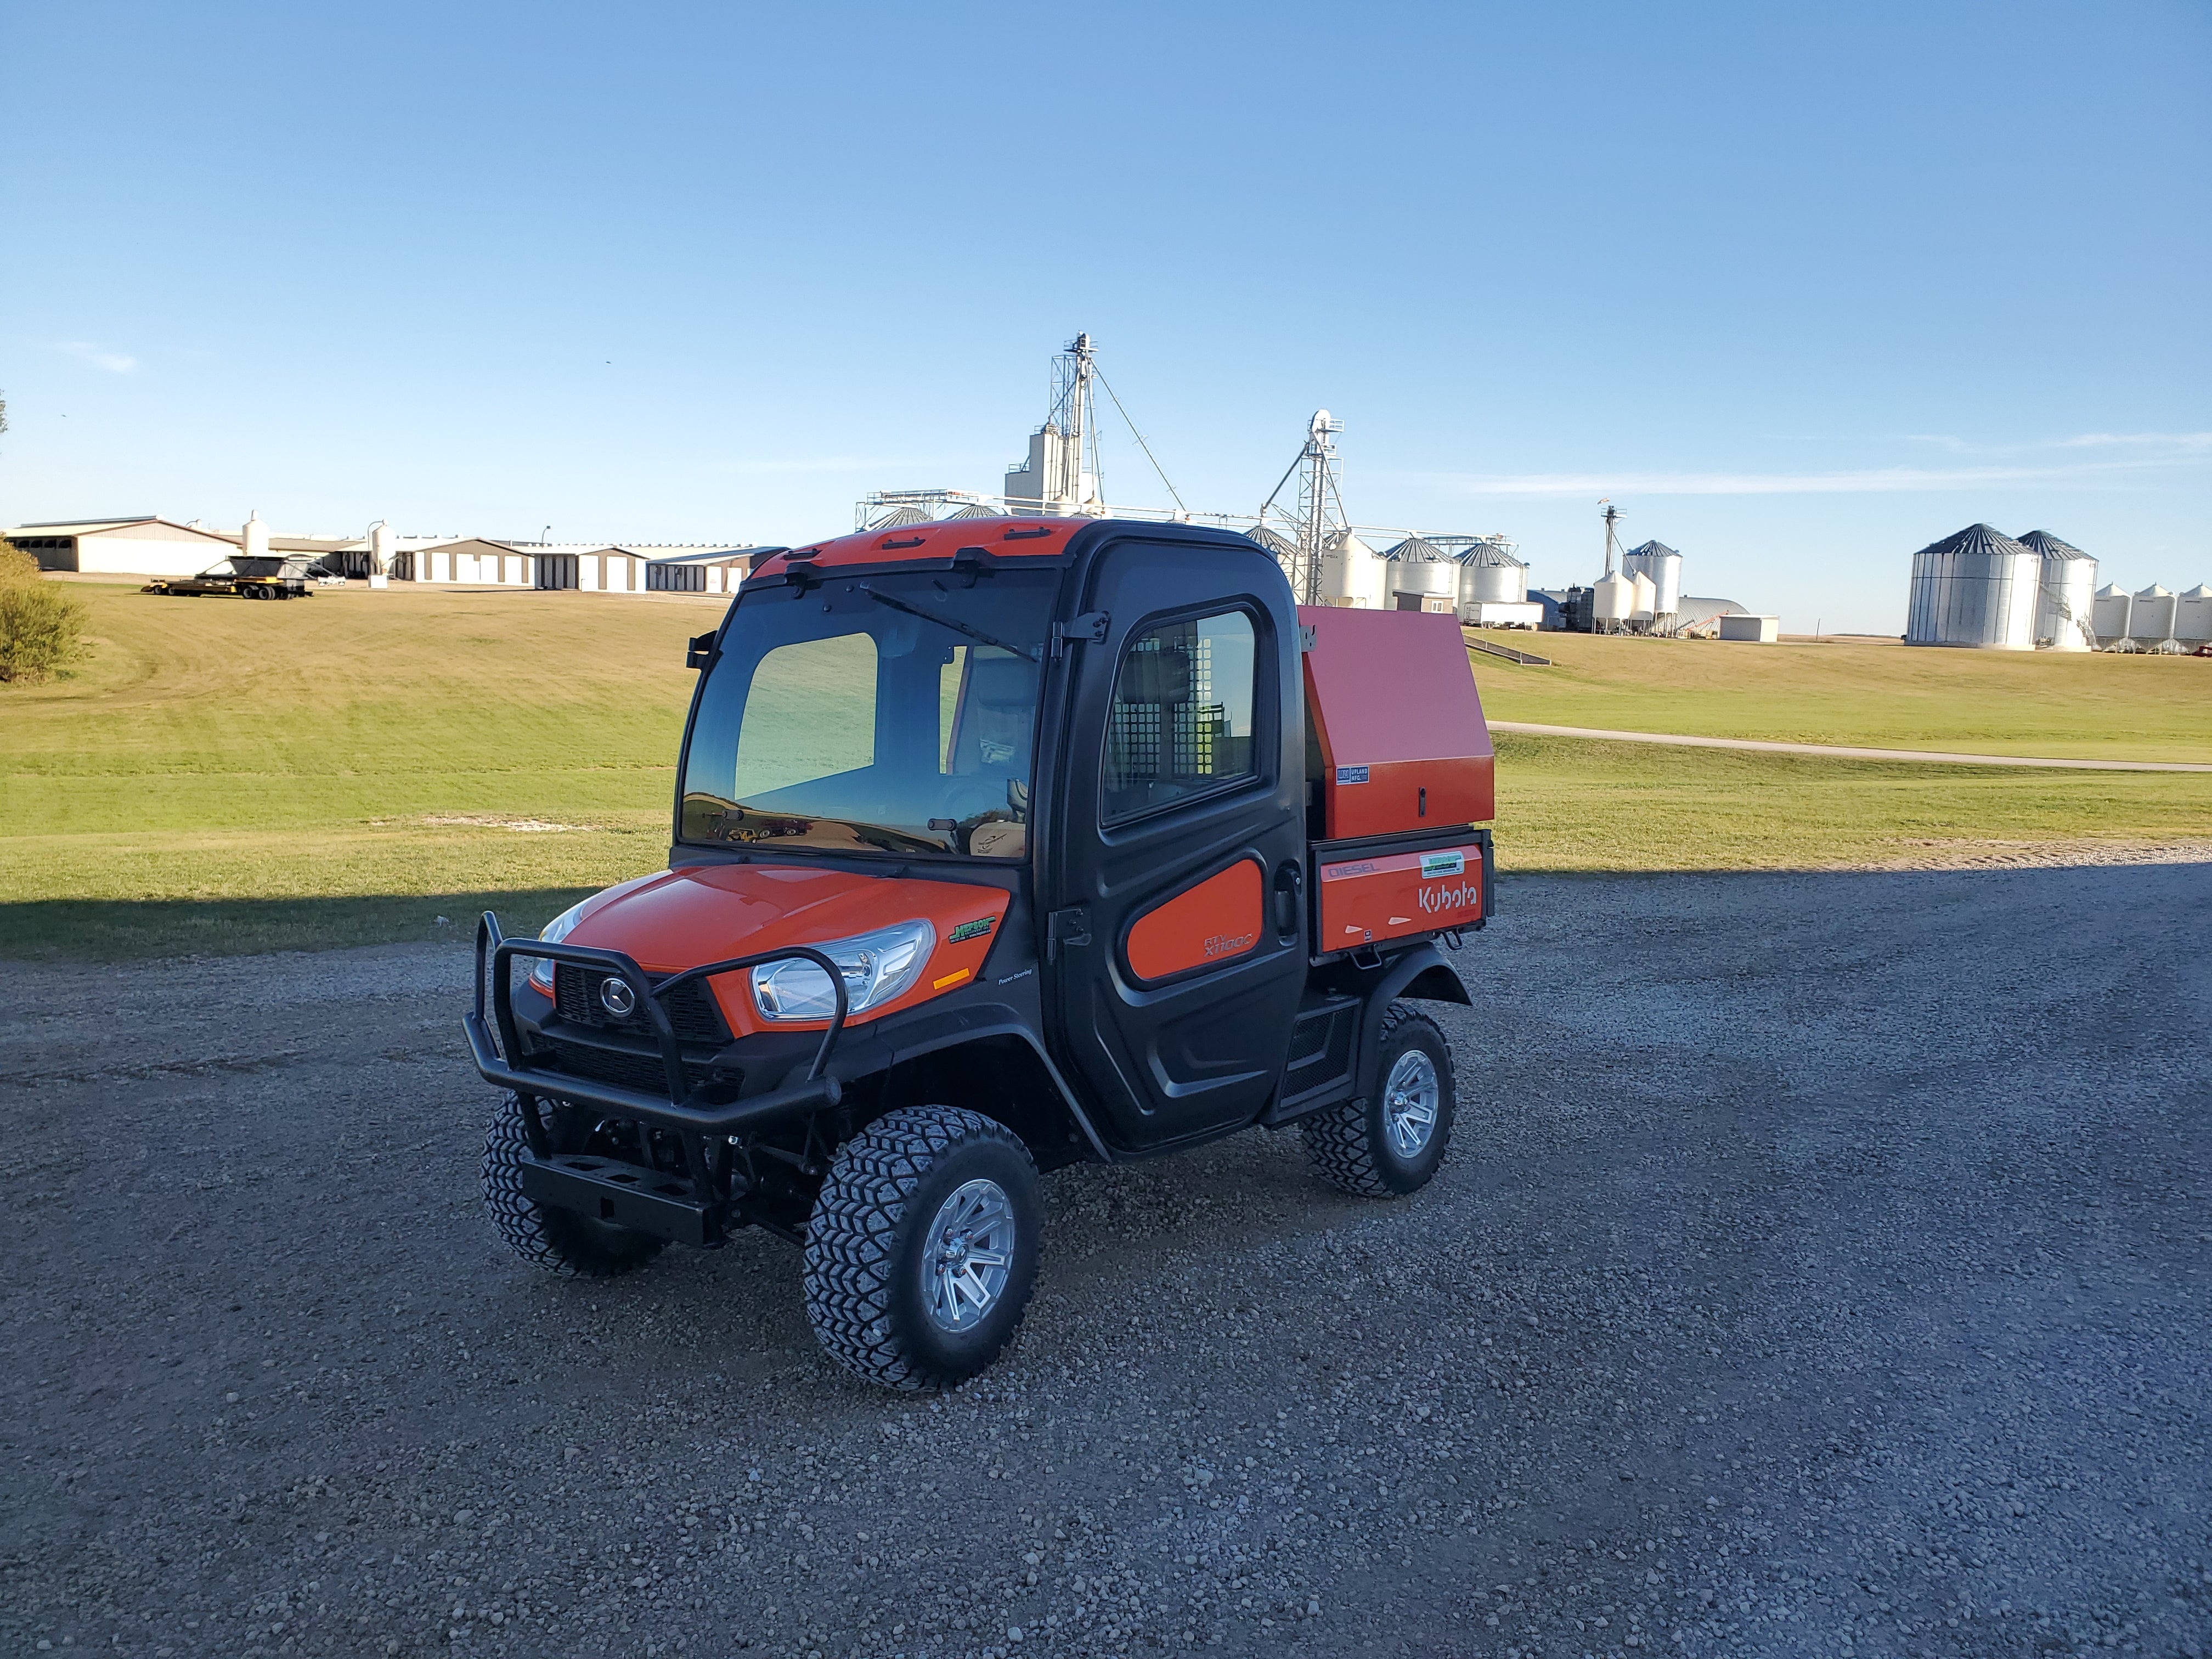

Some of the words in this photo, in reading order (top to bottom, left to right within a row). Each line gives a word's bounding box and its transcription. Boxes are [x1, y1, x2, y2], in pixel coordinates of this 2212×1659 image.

[1329, 863, 1380, 877] DIESEL
[1419, 881, 1476, 913] Kubota
[950, 917, 995, 939] HEPSON
[1204, 934, 1227, 947] RTV
[1204, 934, 1252, 957] X1100C
[998, 977, 1013, 985] Power
[1013, 969, 1032, 979] Steering
